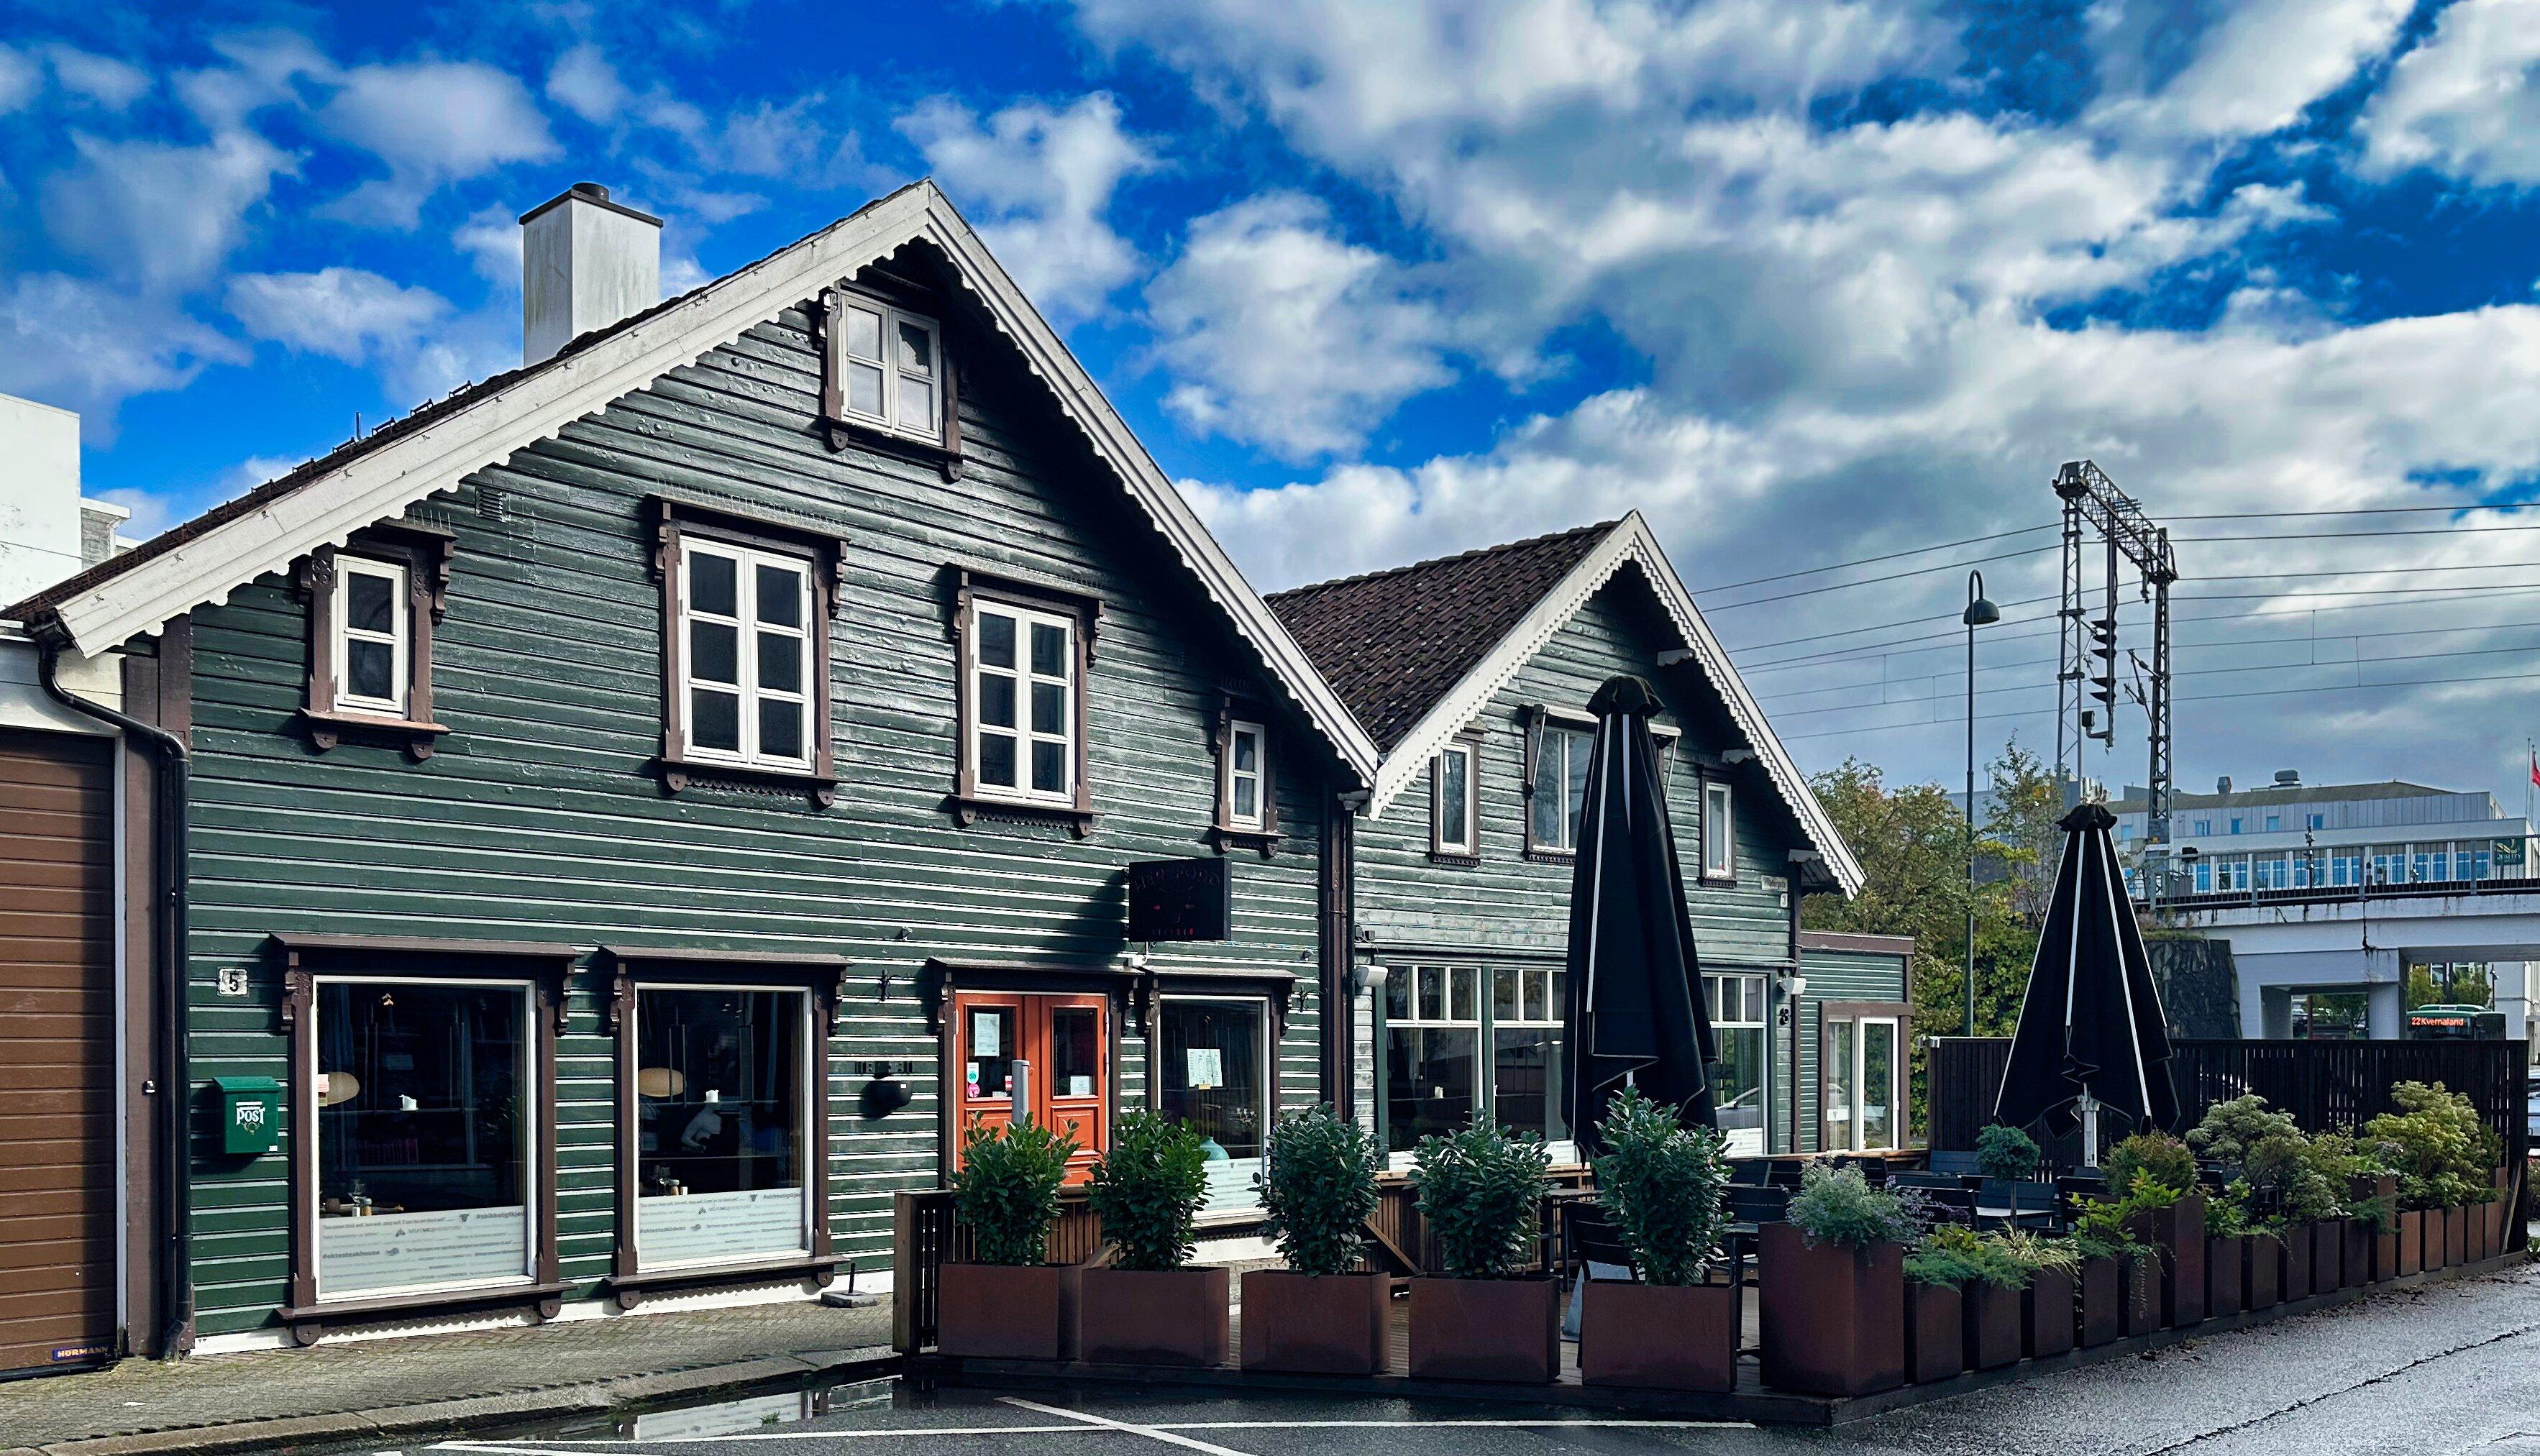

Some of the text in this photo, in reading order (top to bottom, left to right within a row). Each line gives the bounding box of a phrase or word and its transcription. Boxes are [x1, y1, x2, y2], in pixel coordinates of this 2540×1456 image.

[229, 973, 239, 992] 5
[2411, 1017, 2421, 1025] 22
[237, 1107, 265, 1125] POST
